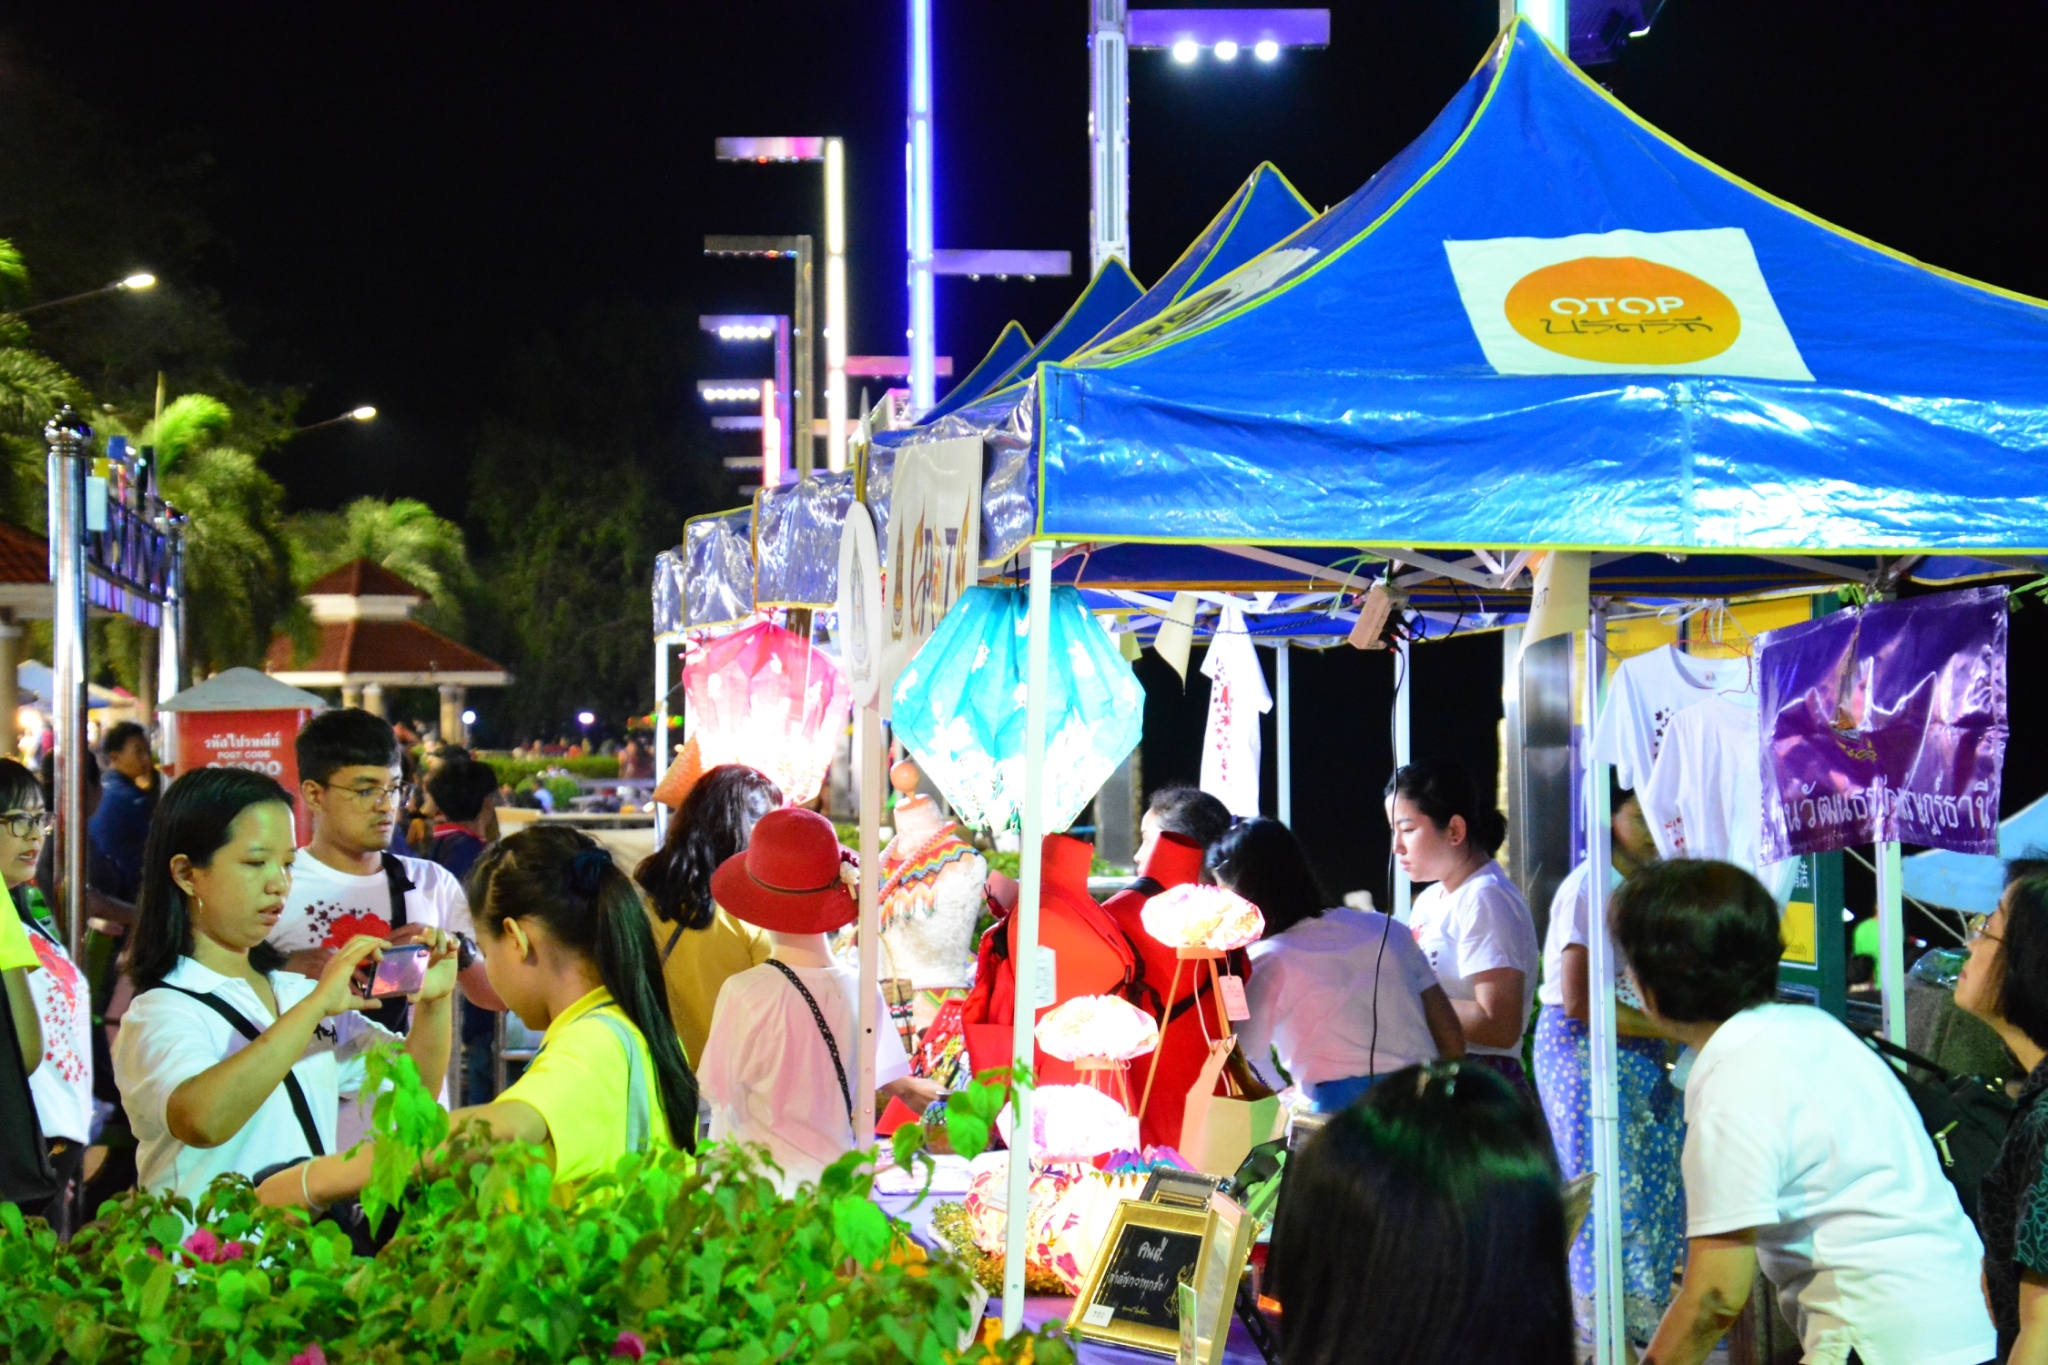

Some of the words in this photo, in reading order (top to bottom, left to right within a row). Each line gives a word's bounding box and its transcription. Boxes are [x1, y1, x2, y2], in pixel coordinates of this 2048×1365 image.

[1550, 296, 1685, 316] OTOP
[203, 731, 282, 749] รหัสไปรษณีย์
[216, 751, 241, 759] POST
[244, 750, 271, 759] CODE
